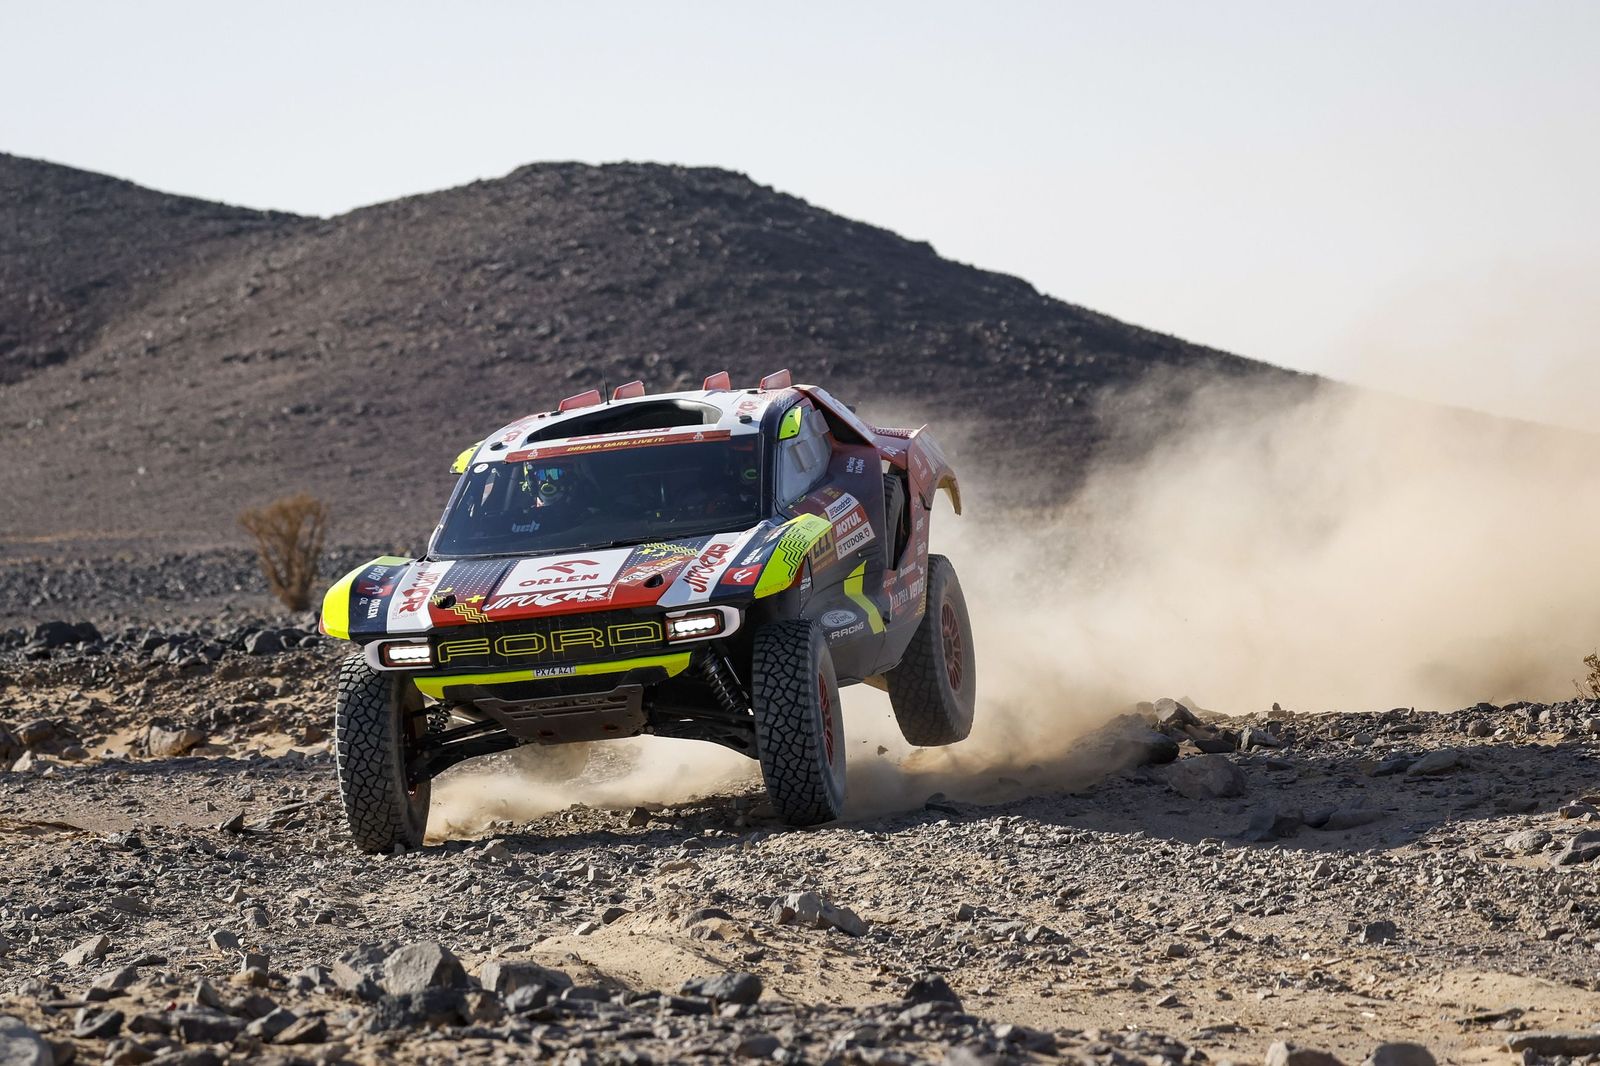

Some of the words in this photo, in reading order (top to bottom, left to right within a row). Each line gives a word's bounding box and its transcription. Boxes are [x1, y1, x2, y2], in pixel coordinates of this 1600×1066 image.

[835, 511, 862, 538] MOTUL
[842, 531, 865, 551] TUDOR
[518, 573, 600, 587] ORLEN
[683, 543, 736, 593] JIPOCAR
[366, 598, 381, 619] ORLEN
[481, 586, 609, 611] JIPOCAR
[437, 621, 664, 663] FORD
